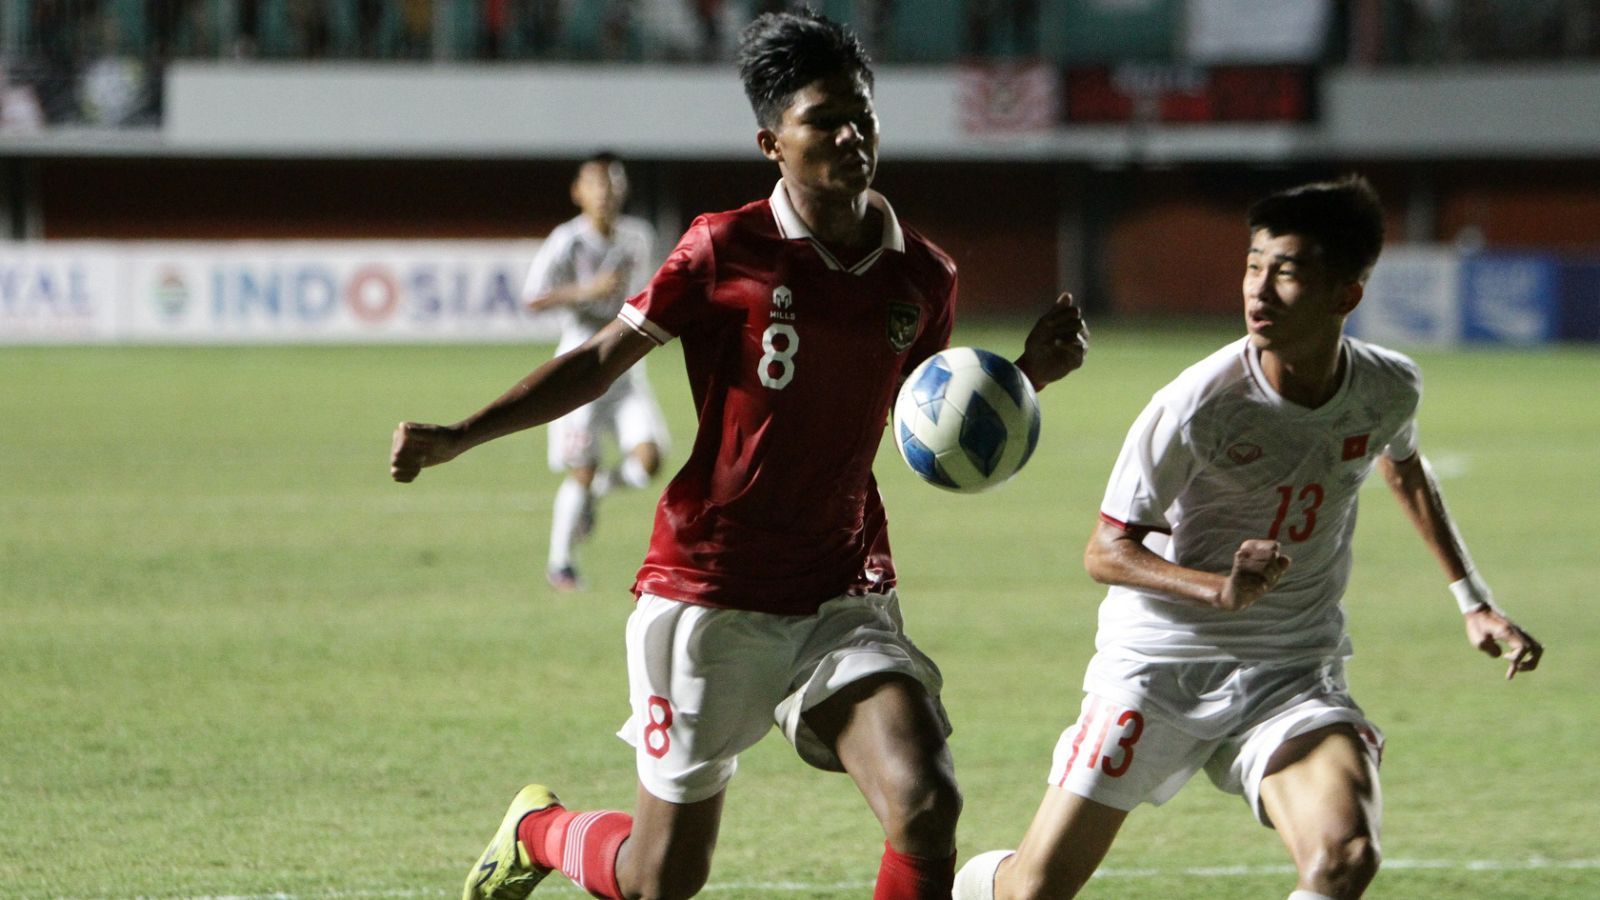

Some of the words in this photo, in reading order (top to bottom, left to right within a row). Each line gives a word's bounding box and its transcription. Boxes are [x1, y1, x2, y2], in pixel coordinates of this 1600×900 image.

[770, 310, 796, 321] MILLS
[757, 323, 799, 391] 8
[1269, 483, 1324, 543] 13
[644, 695, 673, 759] 8
[1087, 705, 1144, 778] 13
